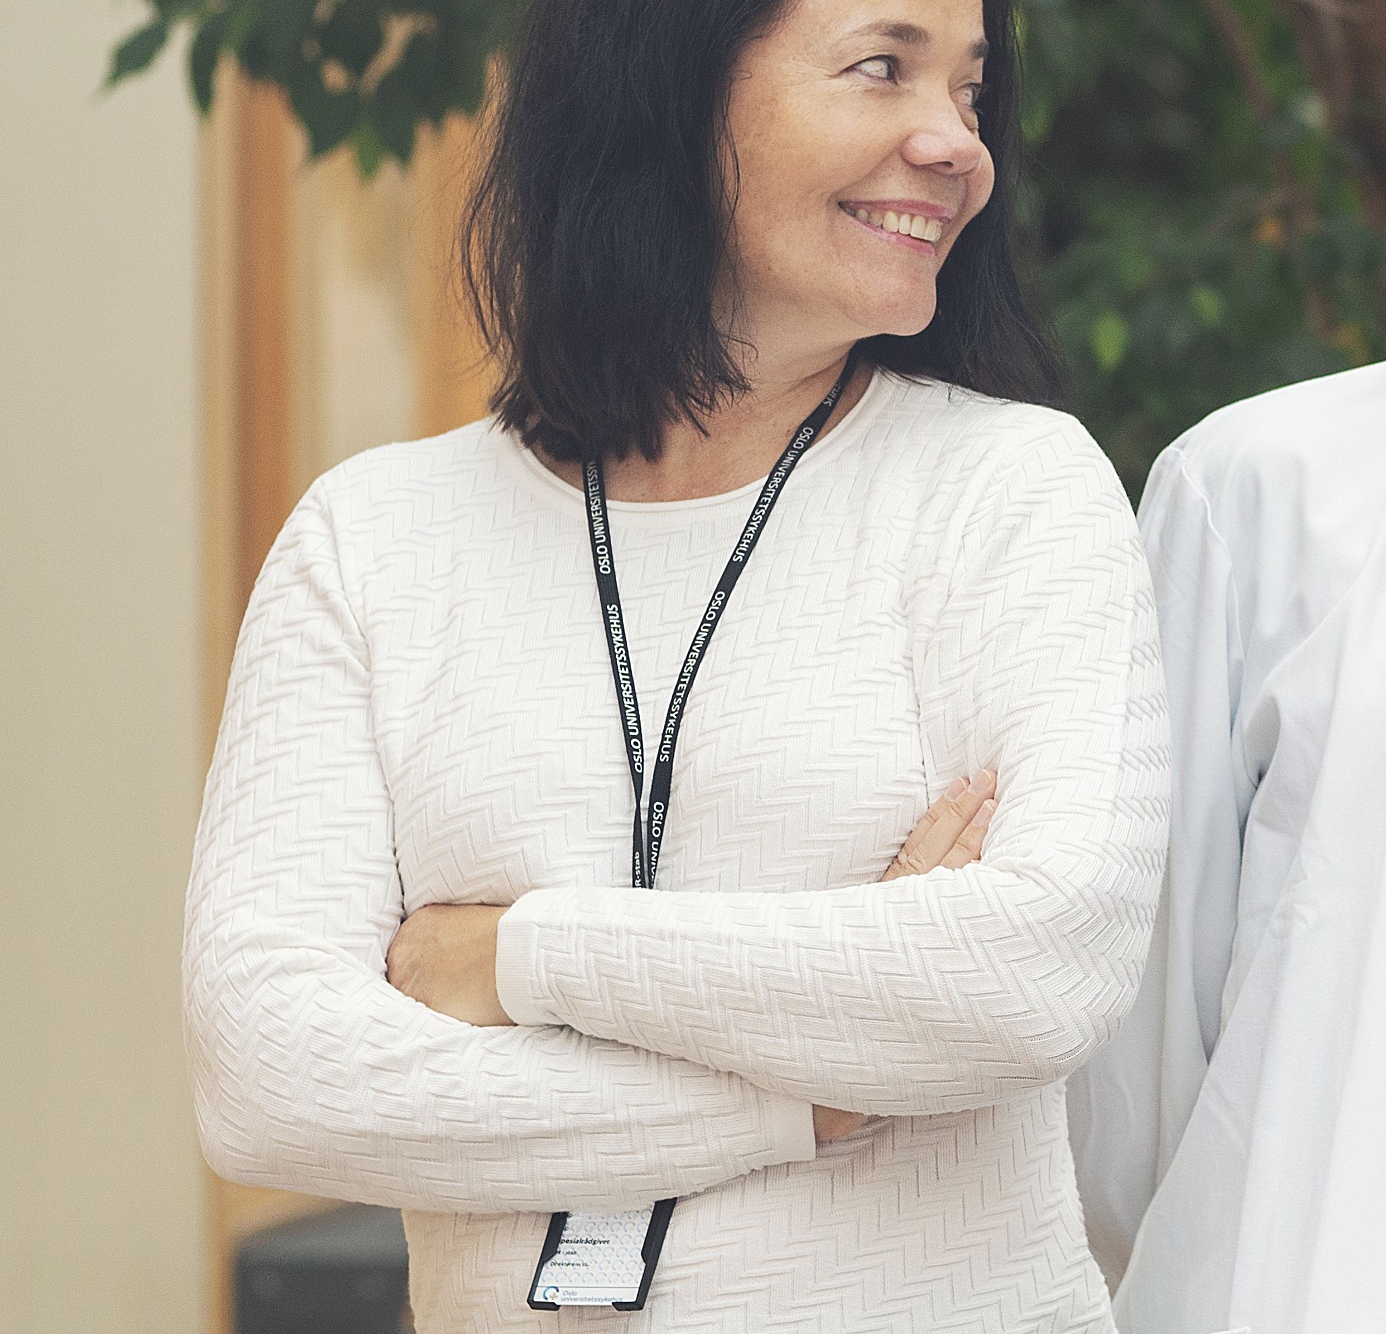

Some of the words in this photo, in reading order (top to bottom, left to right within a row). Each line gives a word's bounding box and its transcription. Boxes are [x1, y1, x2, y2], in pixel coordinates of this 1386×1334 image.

[793, 427, 814, 449] OSLO
[733, 450, 800, 563] UNIVERSITETSSYKEHUS
[596, 544, 611, 575] OSLO
[705, 591, 726, 621] OSLO
[606, 604, 639, 736] UNIVERSITETSSYKEHUS
[659, 623, 712, 763] UNIVERSITETSSYKEHUS
[630, 738, 642, 774] OSLO
[651, 801, 665, 838] OSLO
[559, 1237, 611, 1246] pesialrådgiver
